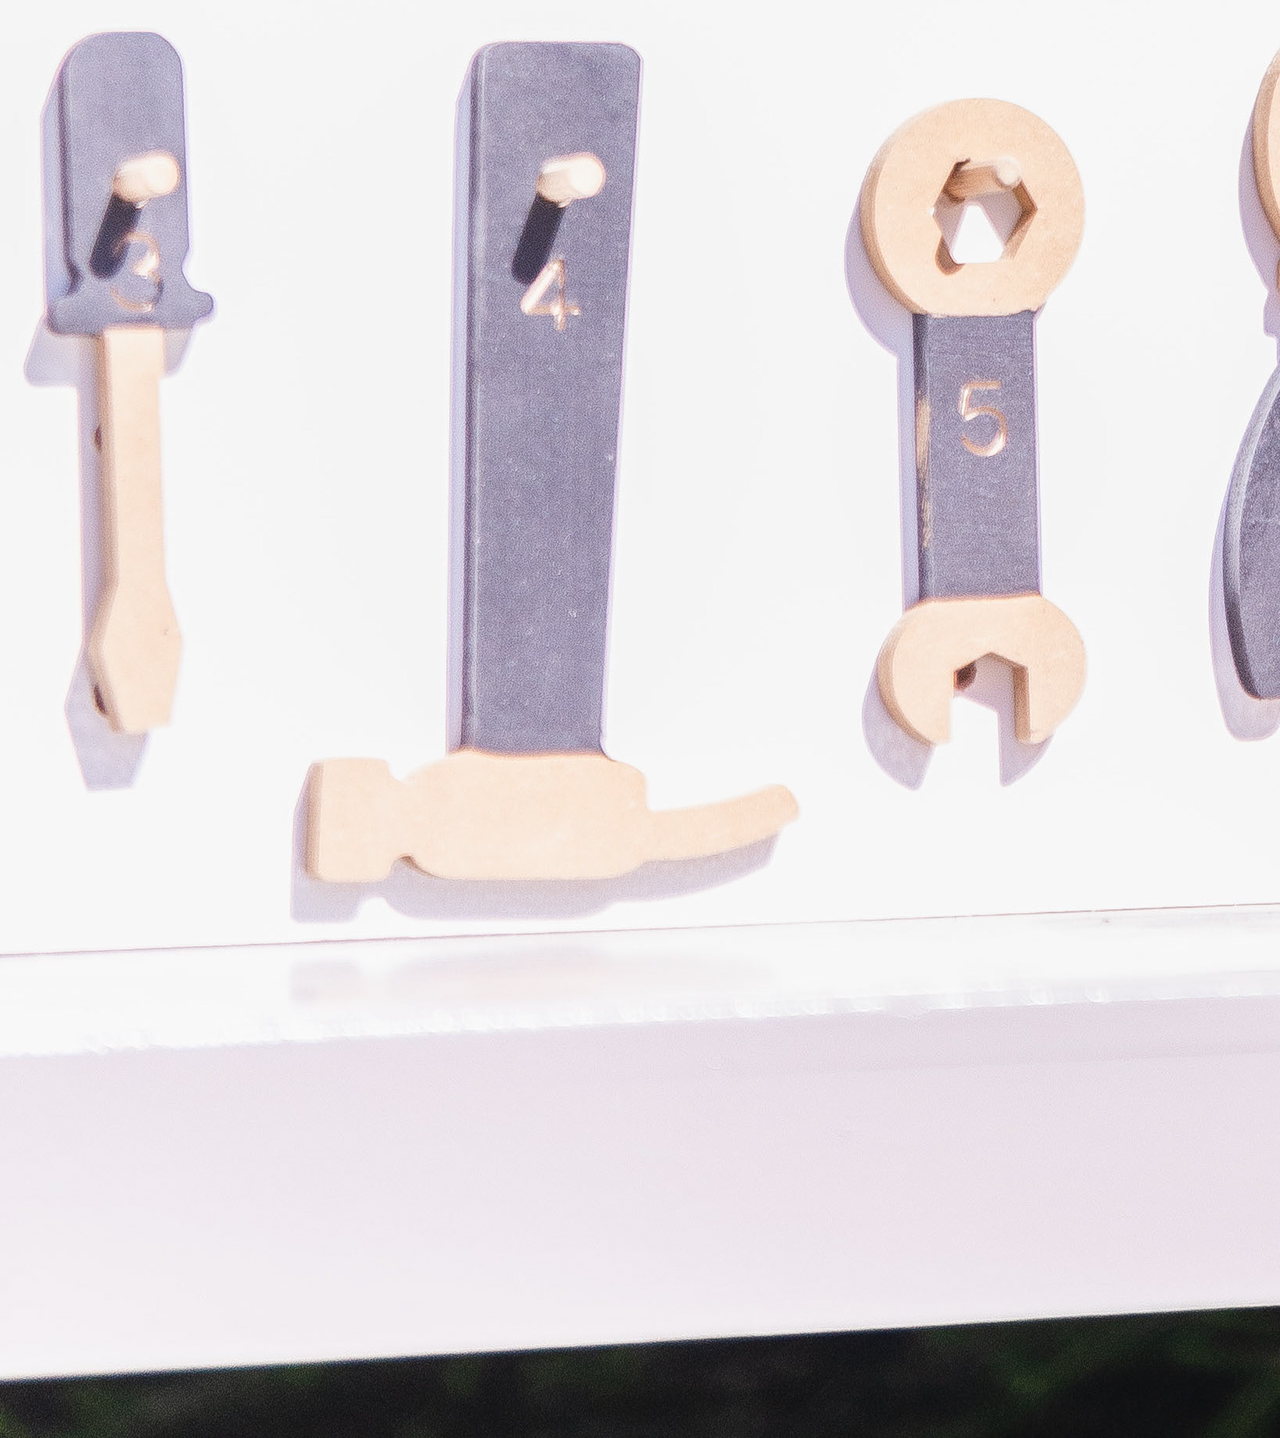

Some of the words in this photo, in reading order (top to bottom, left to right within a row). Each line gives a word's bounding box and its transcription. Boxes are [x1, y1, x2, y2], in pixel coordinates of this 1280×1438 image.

[109, 231, 163, 313] 3
[521, 258, 581, 330] 4
[958, 380, 1008, 457] 5
